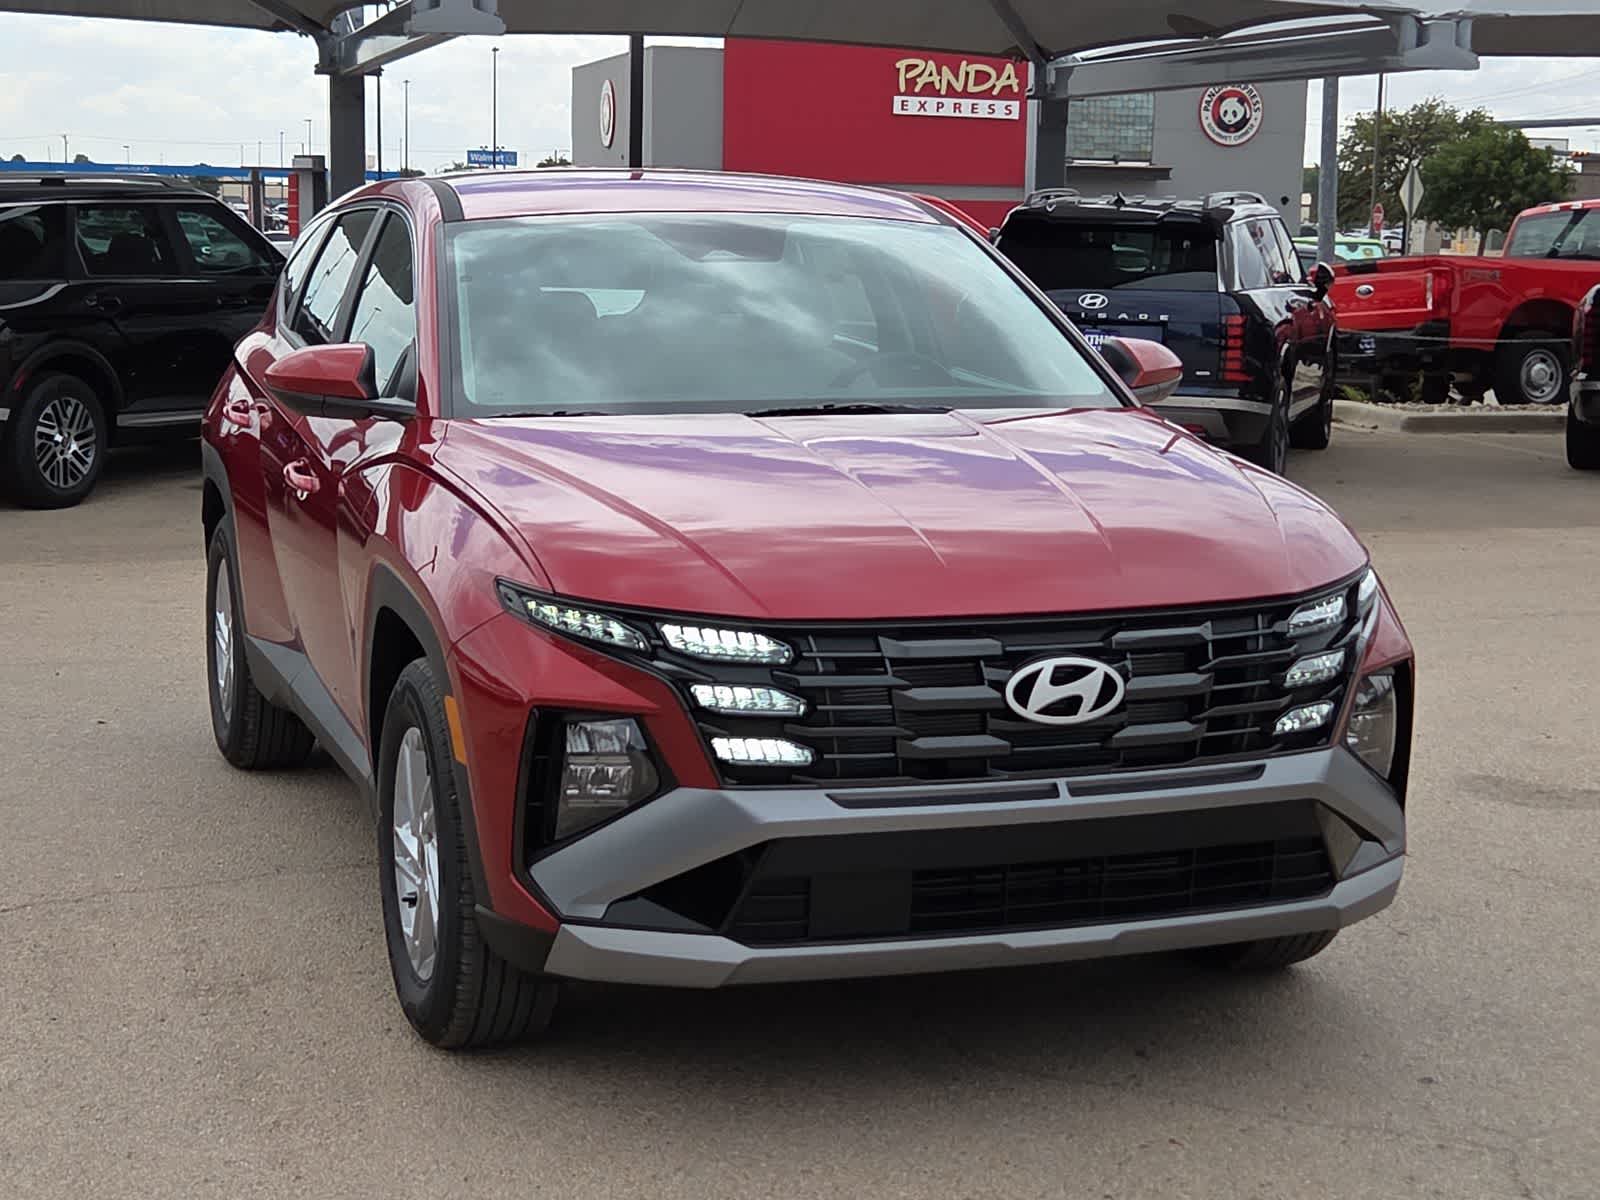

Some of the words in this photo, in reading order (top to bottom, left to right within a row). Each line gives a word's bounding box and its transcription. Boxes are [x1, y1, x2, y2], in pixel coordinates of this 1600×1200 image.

[895, 58, 1020, 96] PANDA
[899, 99, 1012, 117] EXPRESS
[1081, 311, 1169, 321] ISADE
